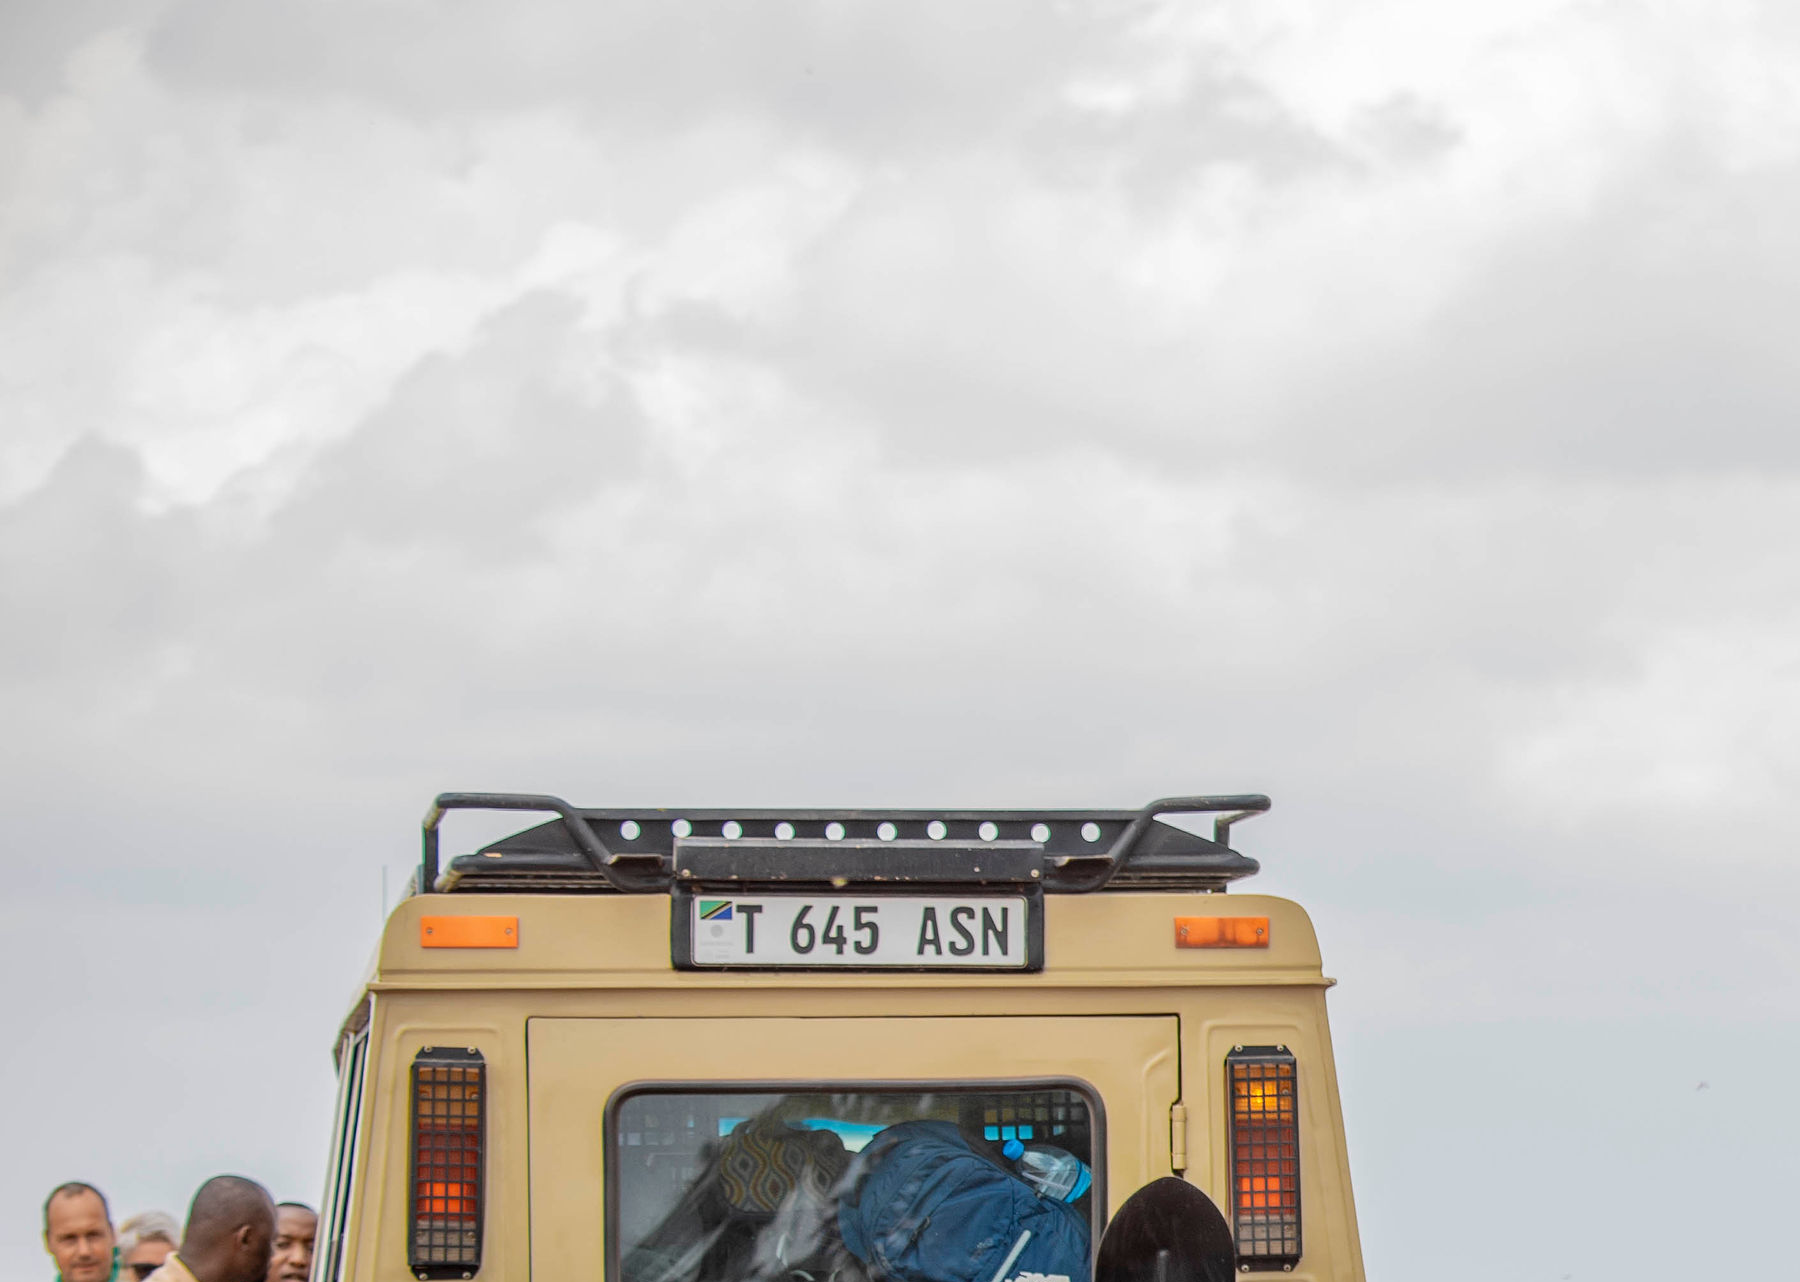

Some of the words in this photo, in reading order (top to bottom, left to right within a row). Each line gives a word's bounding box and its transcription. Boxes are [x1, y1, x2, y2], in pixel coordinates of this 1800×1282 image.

[736, 904, 763, 954] T
[790, 905, 879, 955] 645
[917, 906, 1009, 956] ASN
